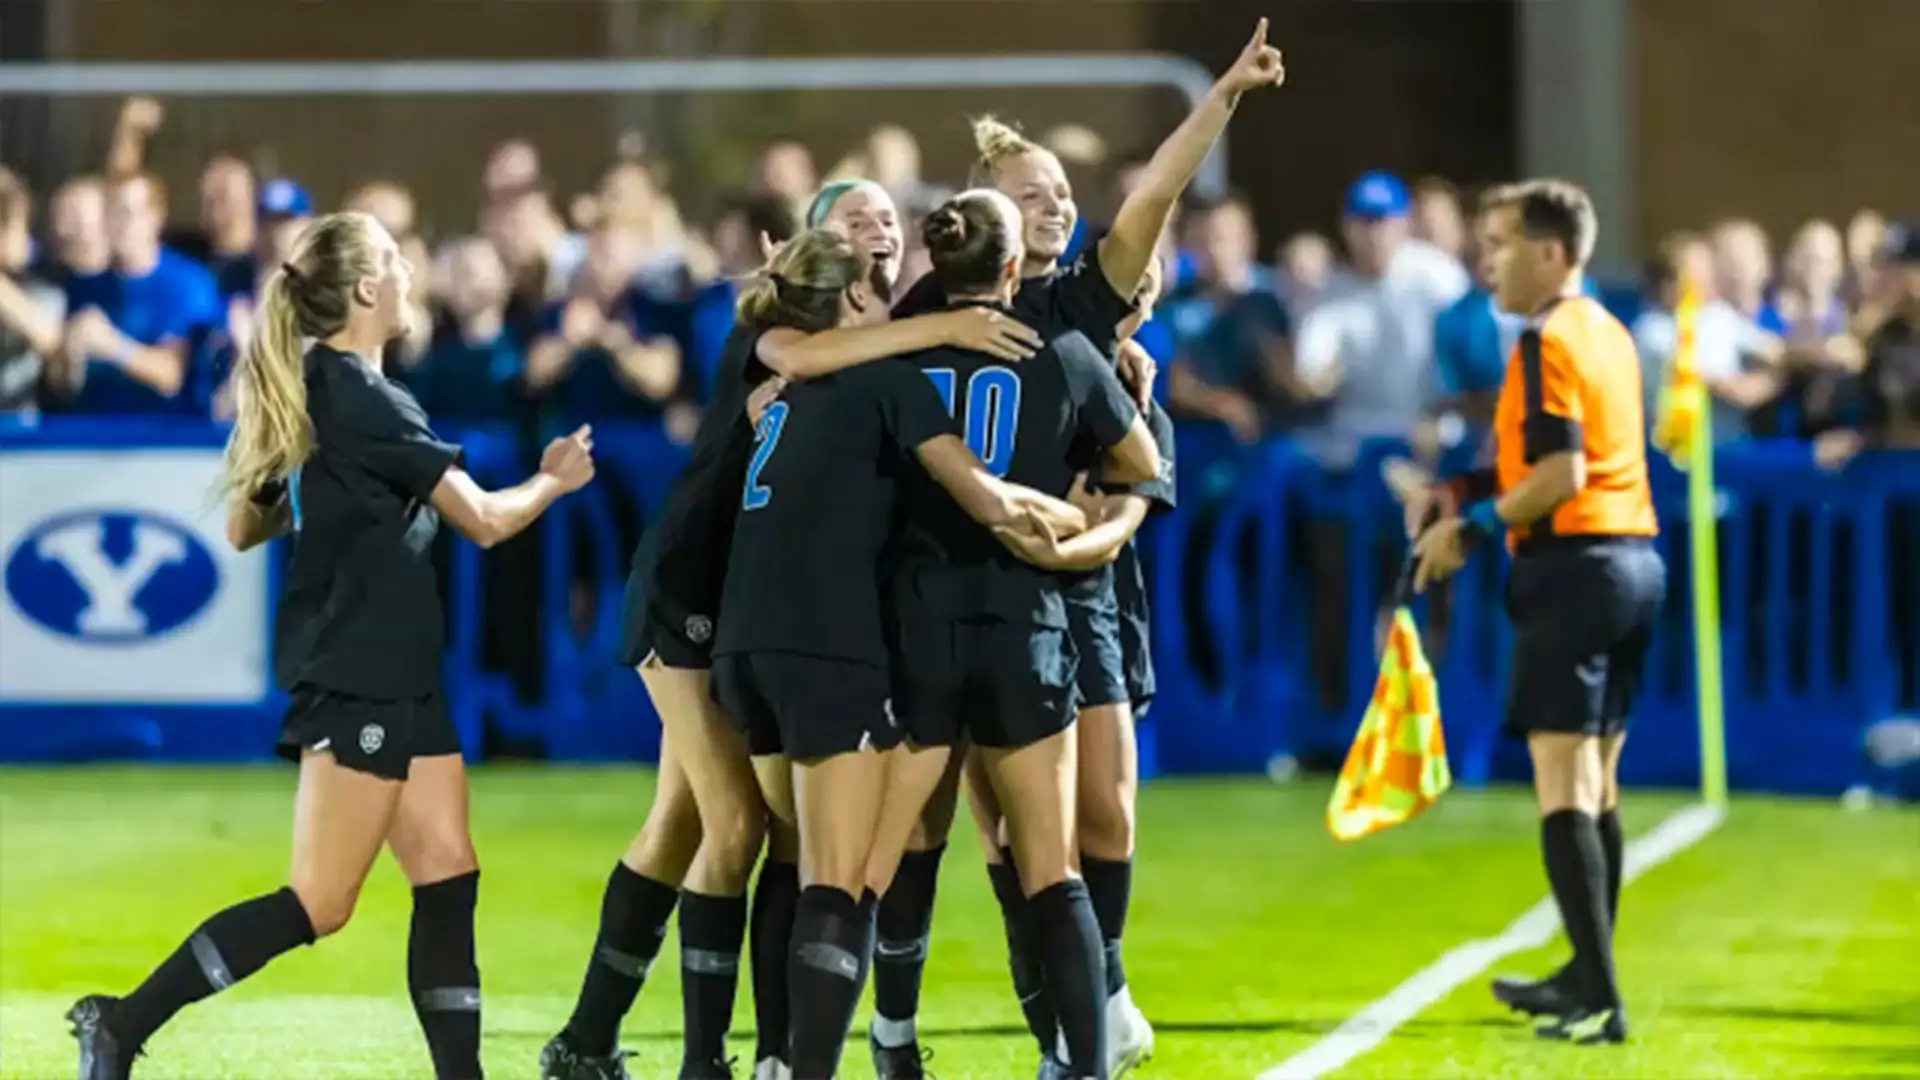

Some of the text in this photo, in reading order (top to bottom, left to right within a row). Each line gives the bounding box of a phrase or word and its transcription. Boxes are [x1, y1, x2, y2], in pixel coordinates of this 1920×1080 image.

[743, 401, 789, 510] 2
[921, 366, 1021, 478] 0
[37, 522, 187, 635] Y
